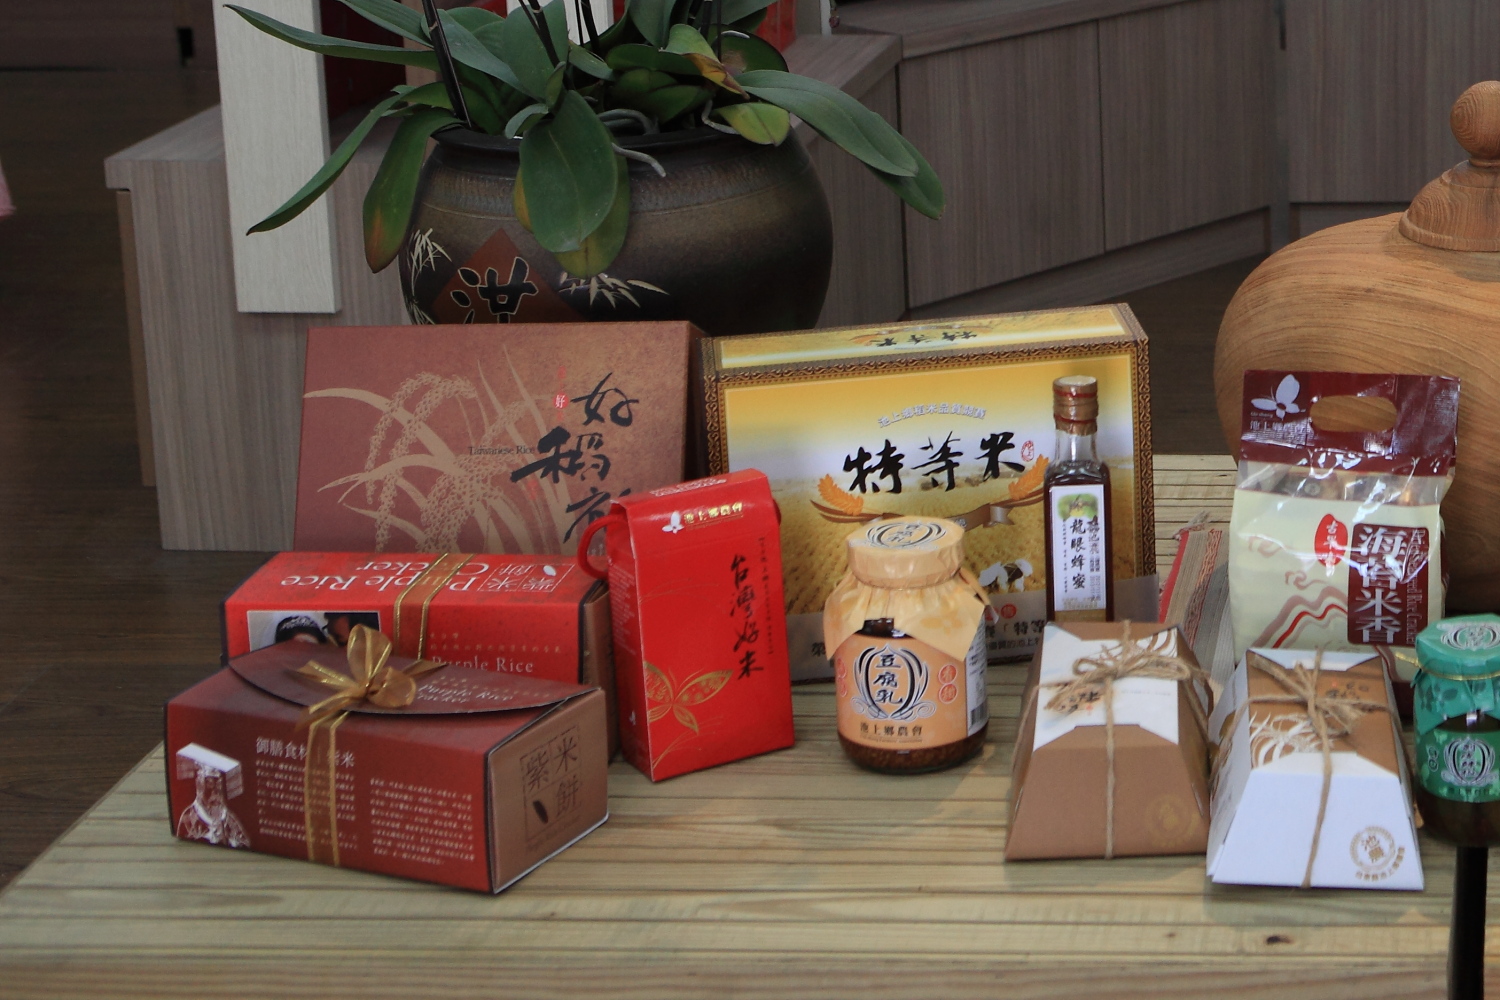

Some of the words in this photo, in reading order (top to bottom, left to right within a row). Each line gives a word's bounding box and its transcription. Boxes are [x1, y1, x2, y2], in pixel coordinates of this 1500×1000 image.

[468, 446, 514, 455] Taiwanese
[843, 430, 1026, 495] 特等米
[1070, 519, 1086, 590] 龍眼蜂蜜
[281, 575, 357, 589] Rice
[496, 657, 534, 673] Rice
[873, 654, 903, 705] 豆腐乳
